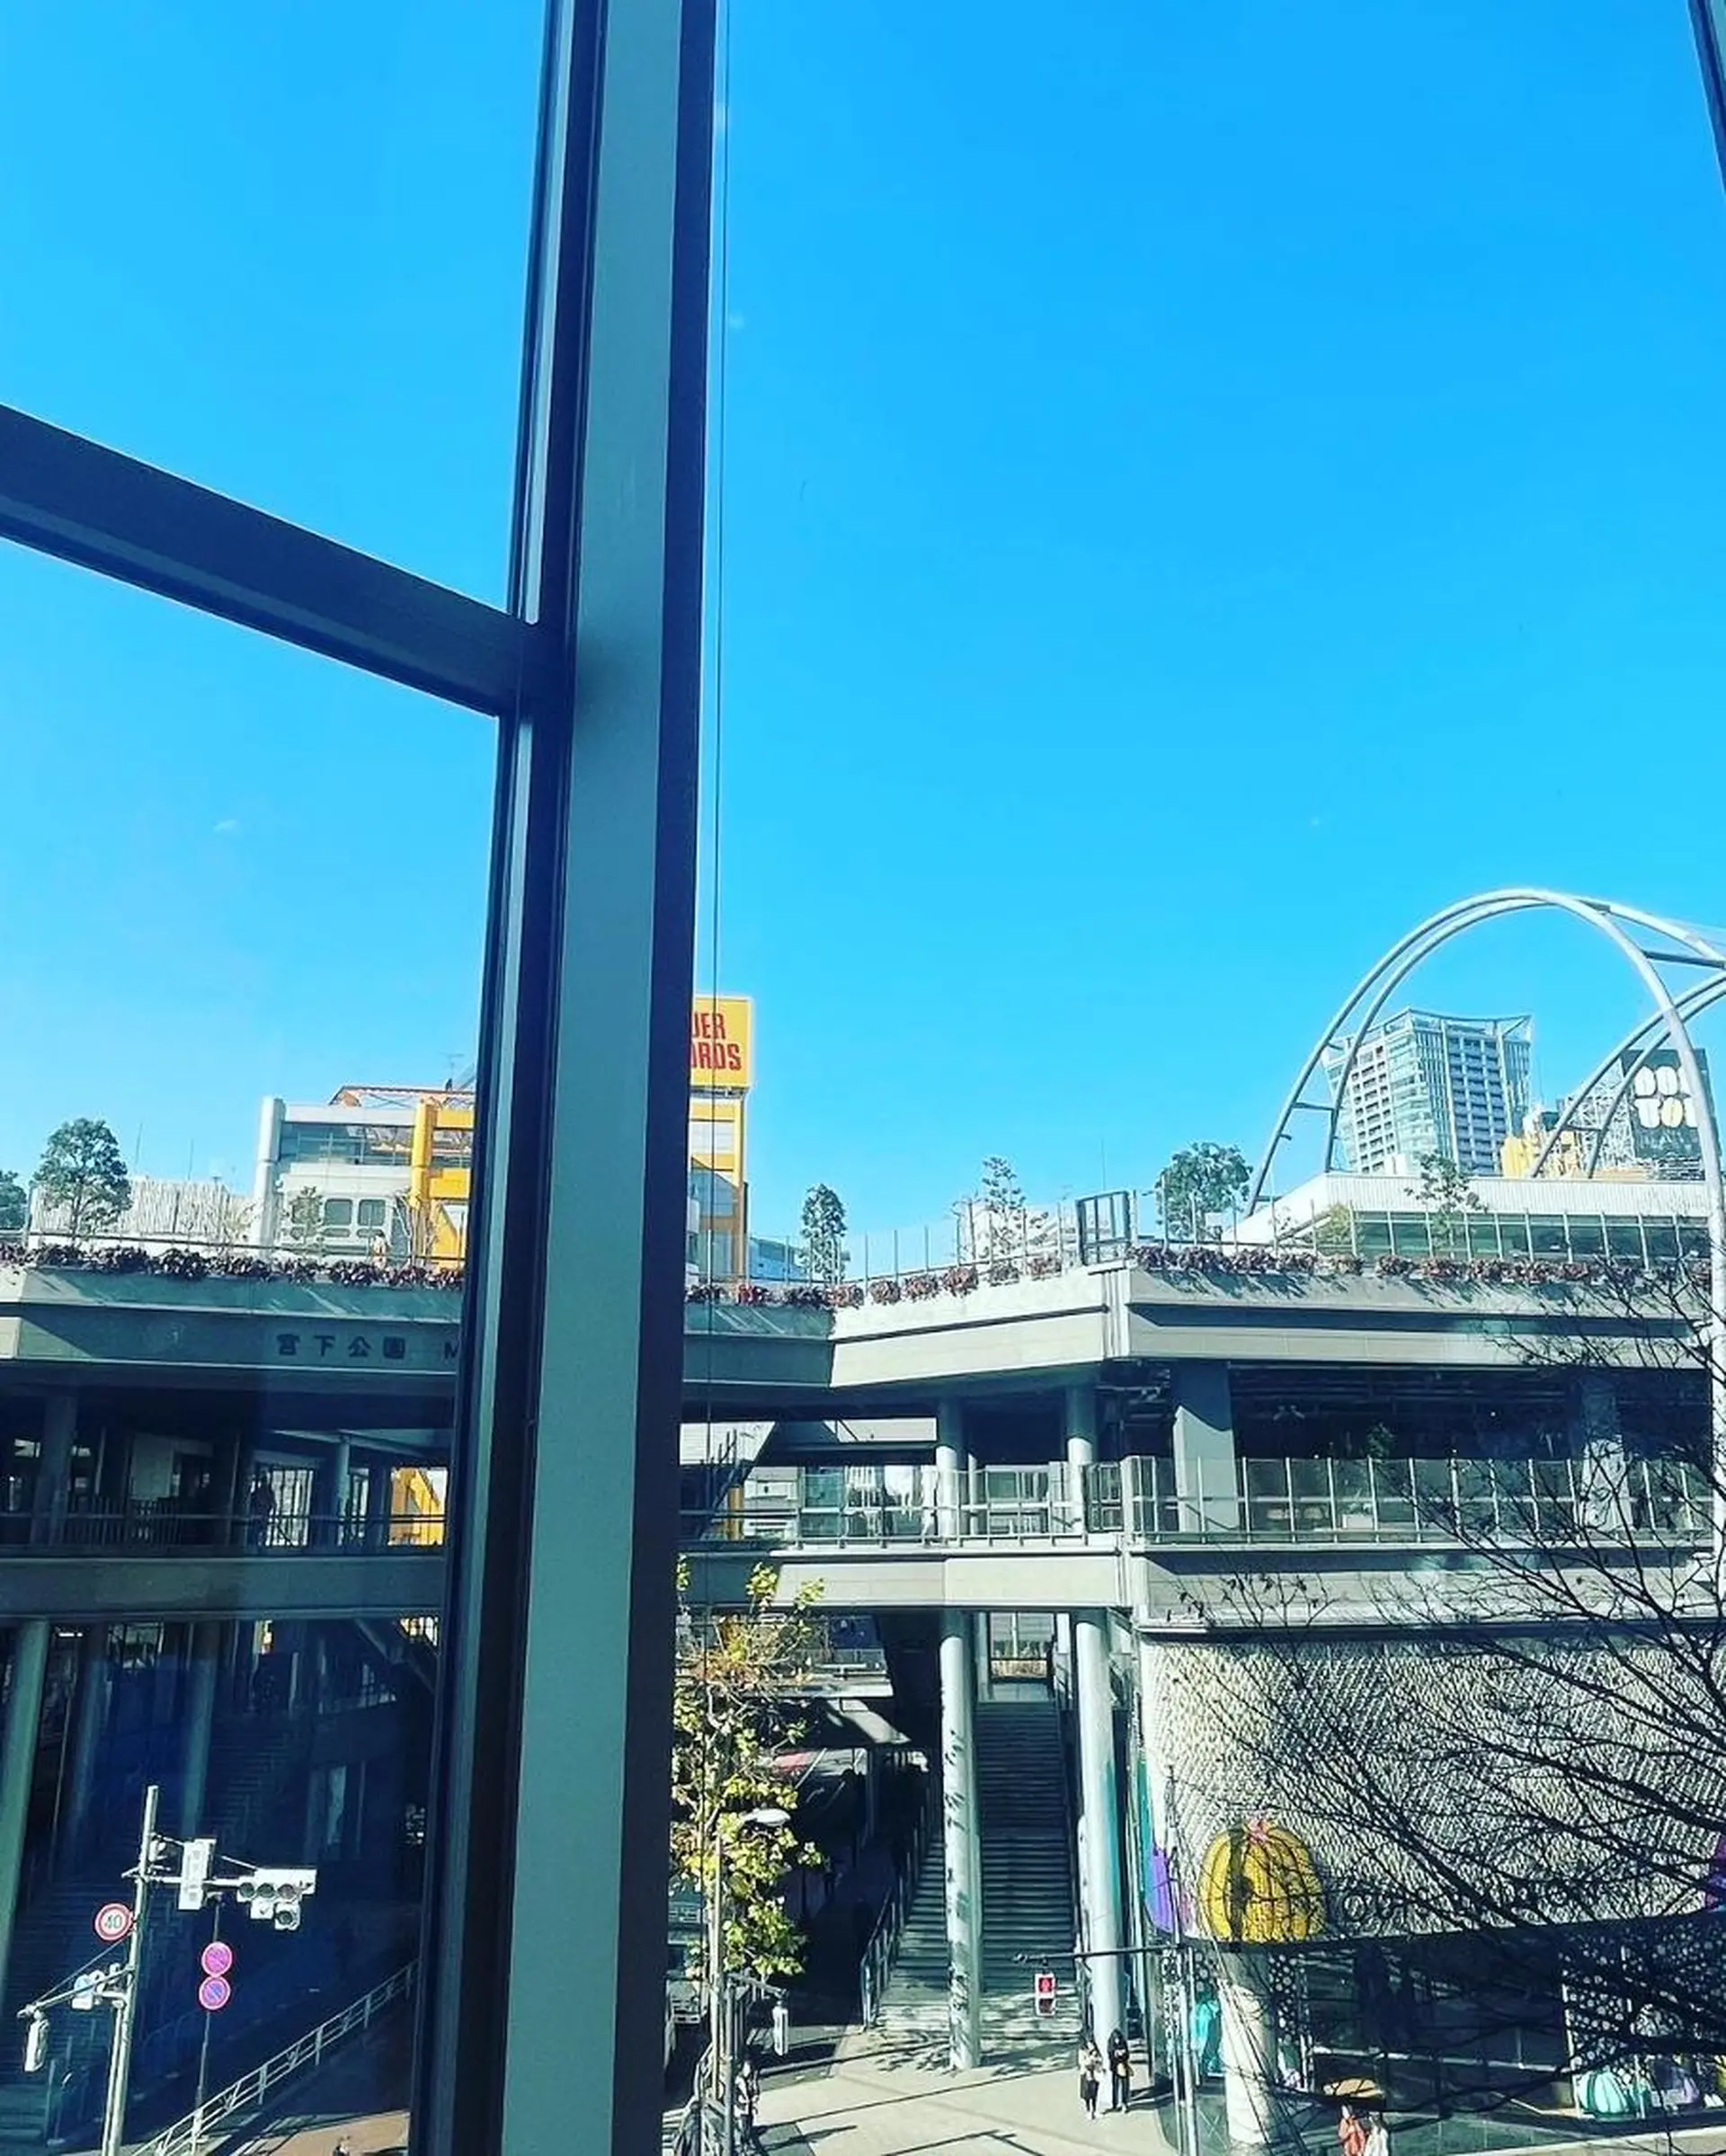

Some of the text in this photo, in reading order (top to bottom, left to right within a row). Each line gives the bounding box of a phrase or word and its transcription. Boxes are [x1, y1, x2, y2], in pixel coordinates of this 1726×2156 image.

[276, 1334, 406, 1360] 宮下公園
[104, 1913, 122, 1929] 40
